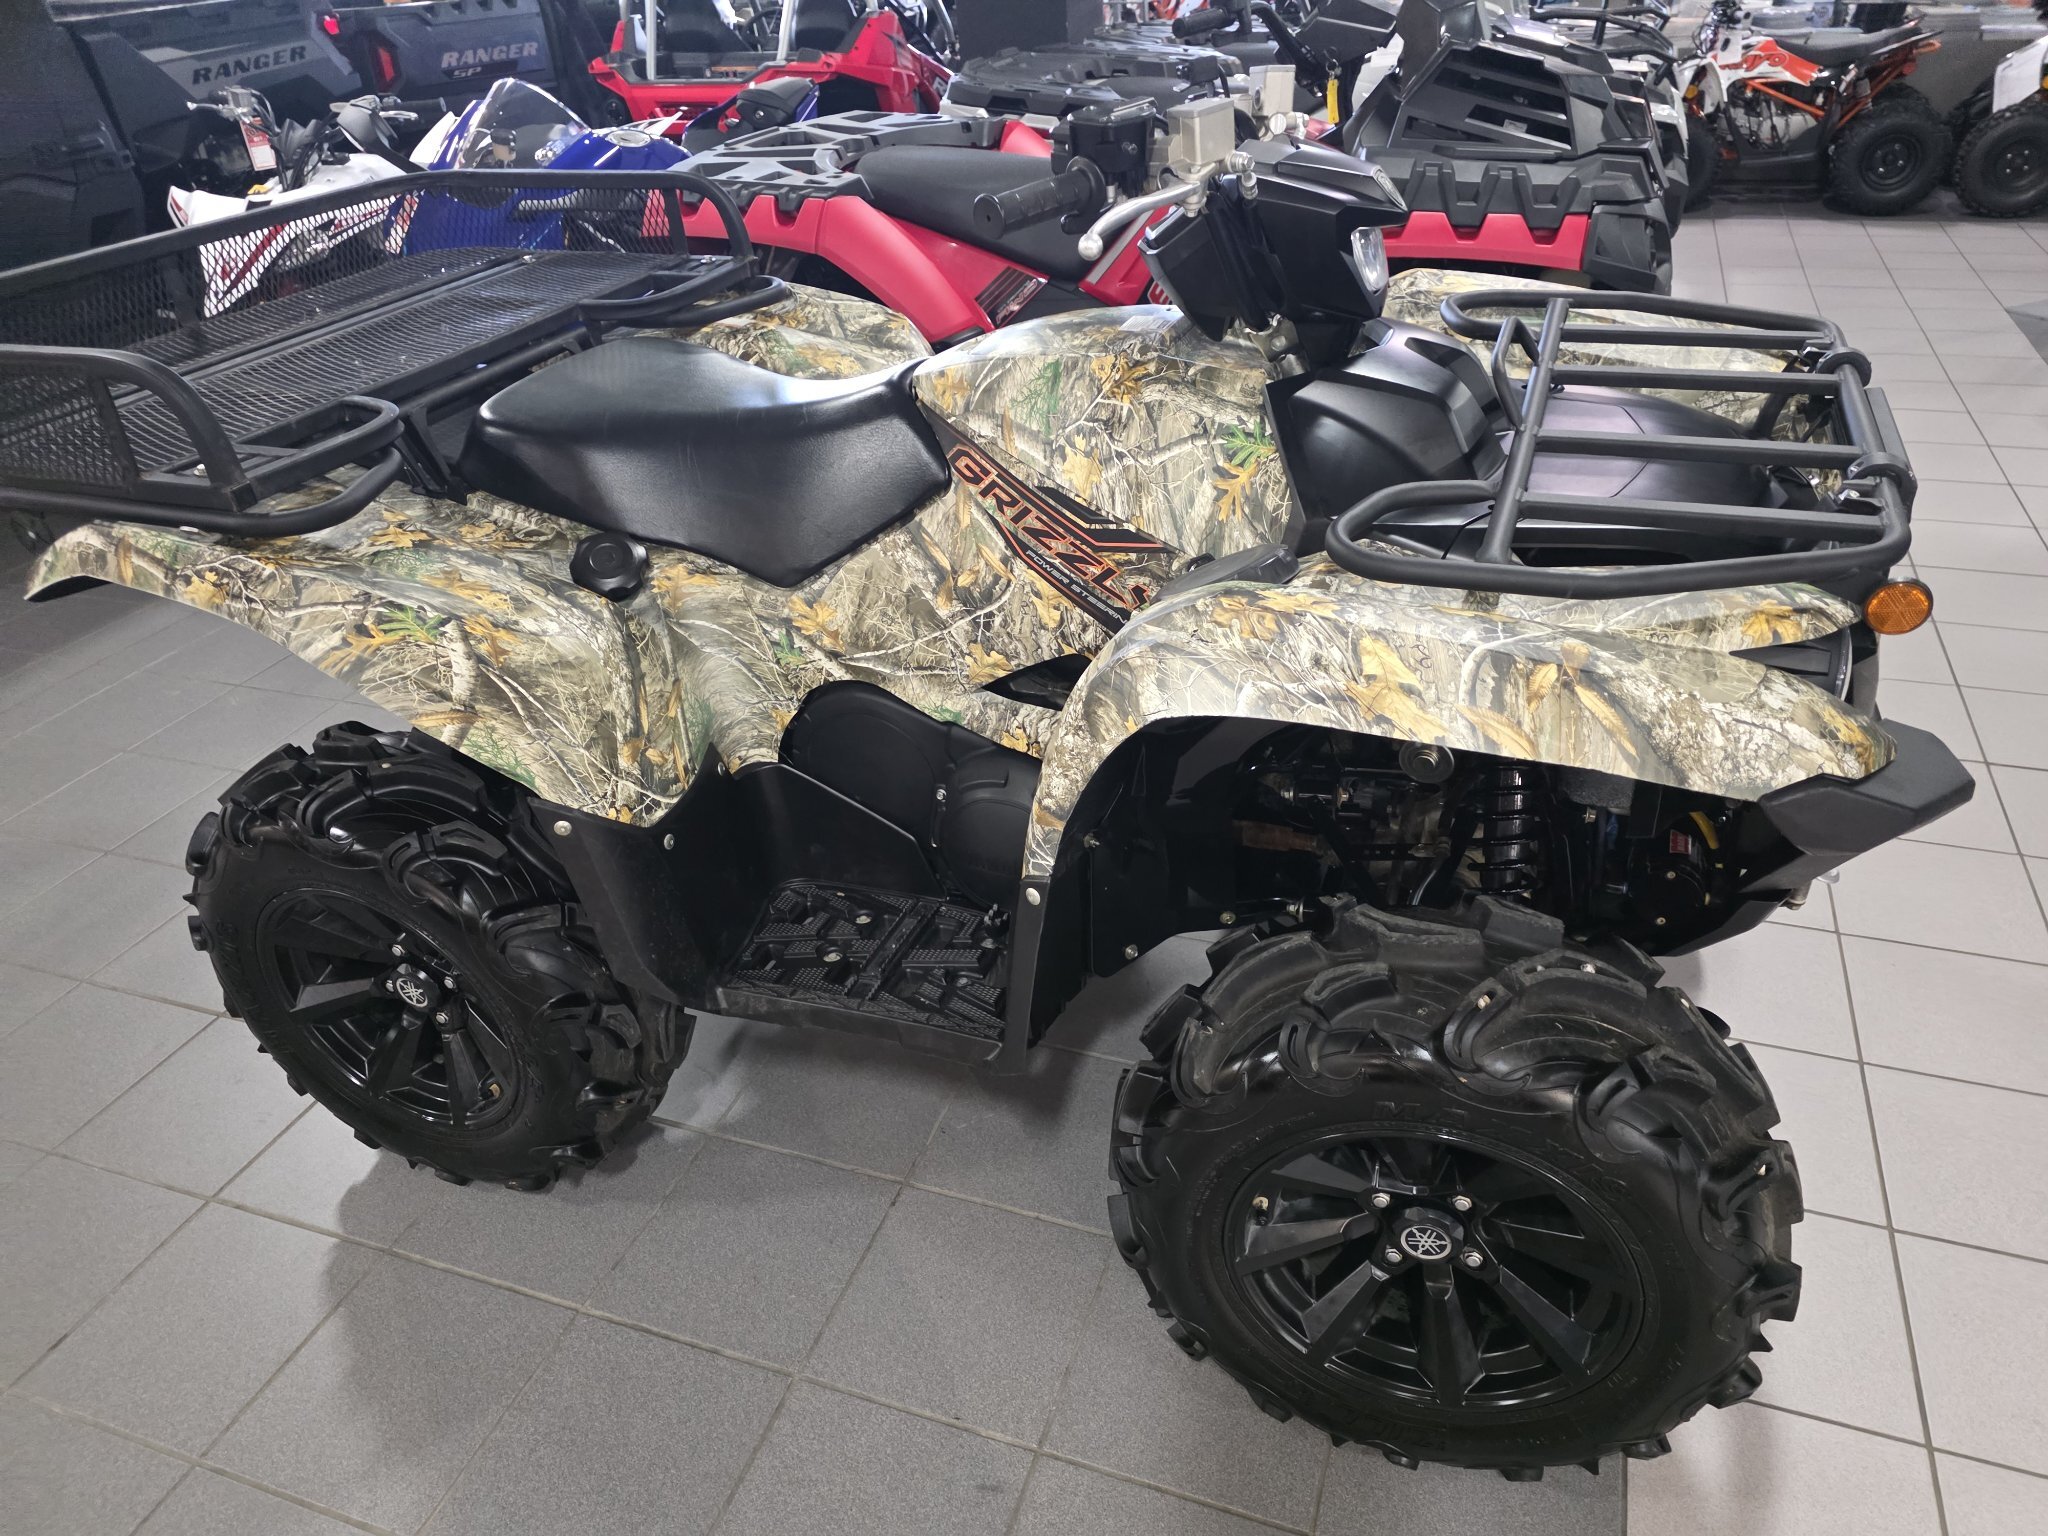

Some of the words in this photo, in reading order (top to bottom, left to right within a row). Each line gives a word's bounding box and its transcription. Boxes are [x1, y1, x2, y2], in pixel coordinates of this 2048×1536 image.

[192, 45, 306, 85] RANGER
[441, 42, 538, 68] RANGER
[453, 66, 482, 79] SP
[1026, 550, 1069, 584] POWER
[1070, 584, 1127, 624] STEERIN
